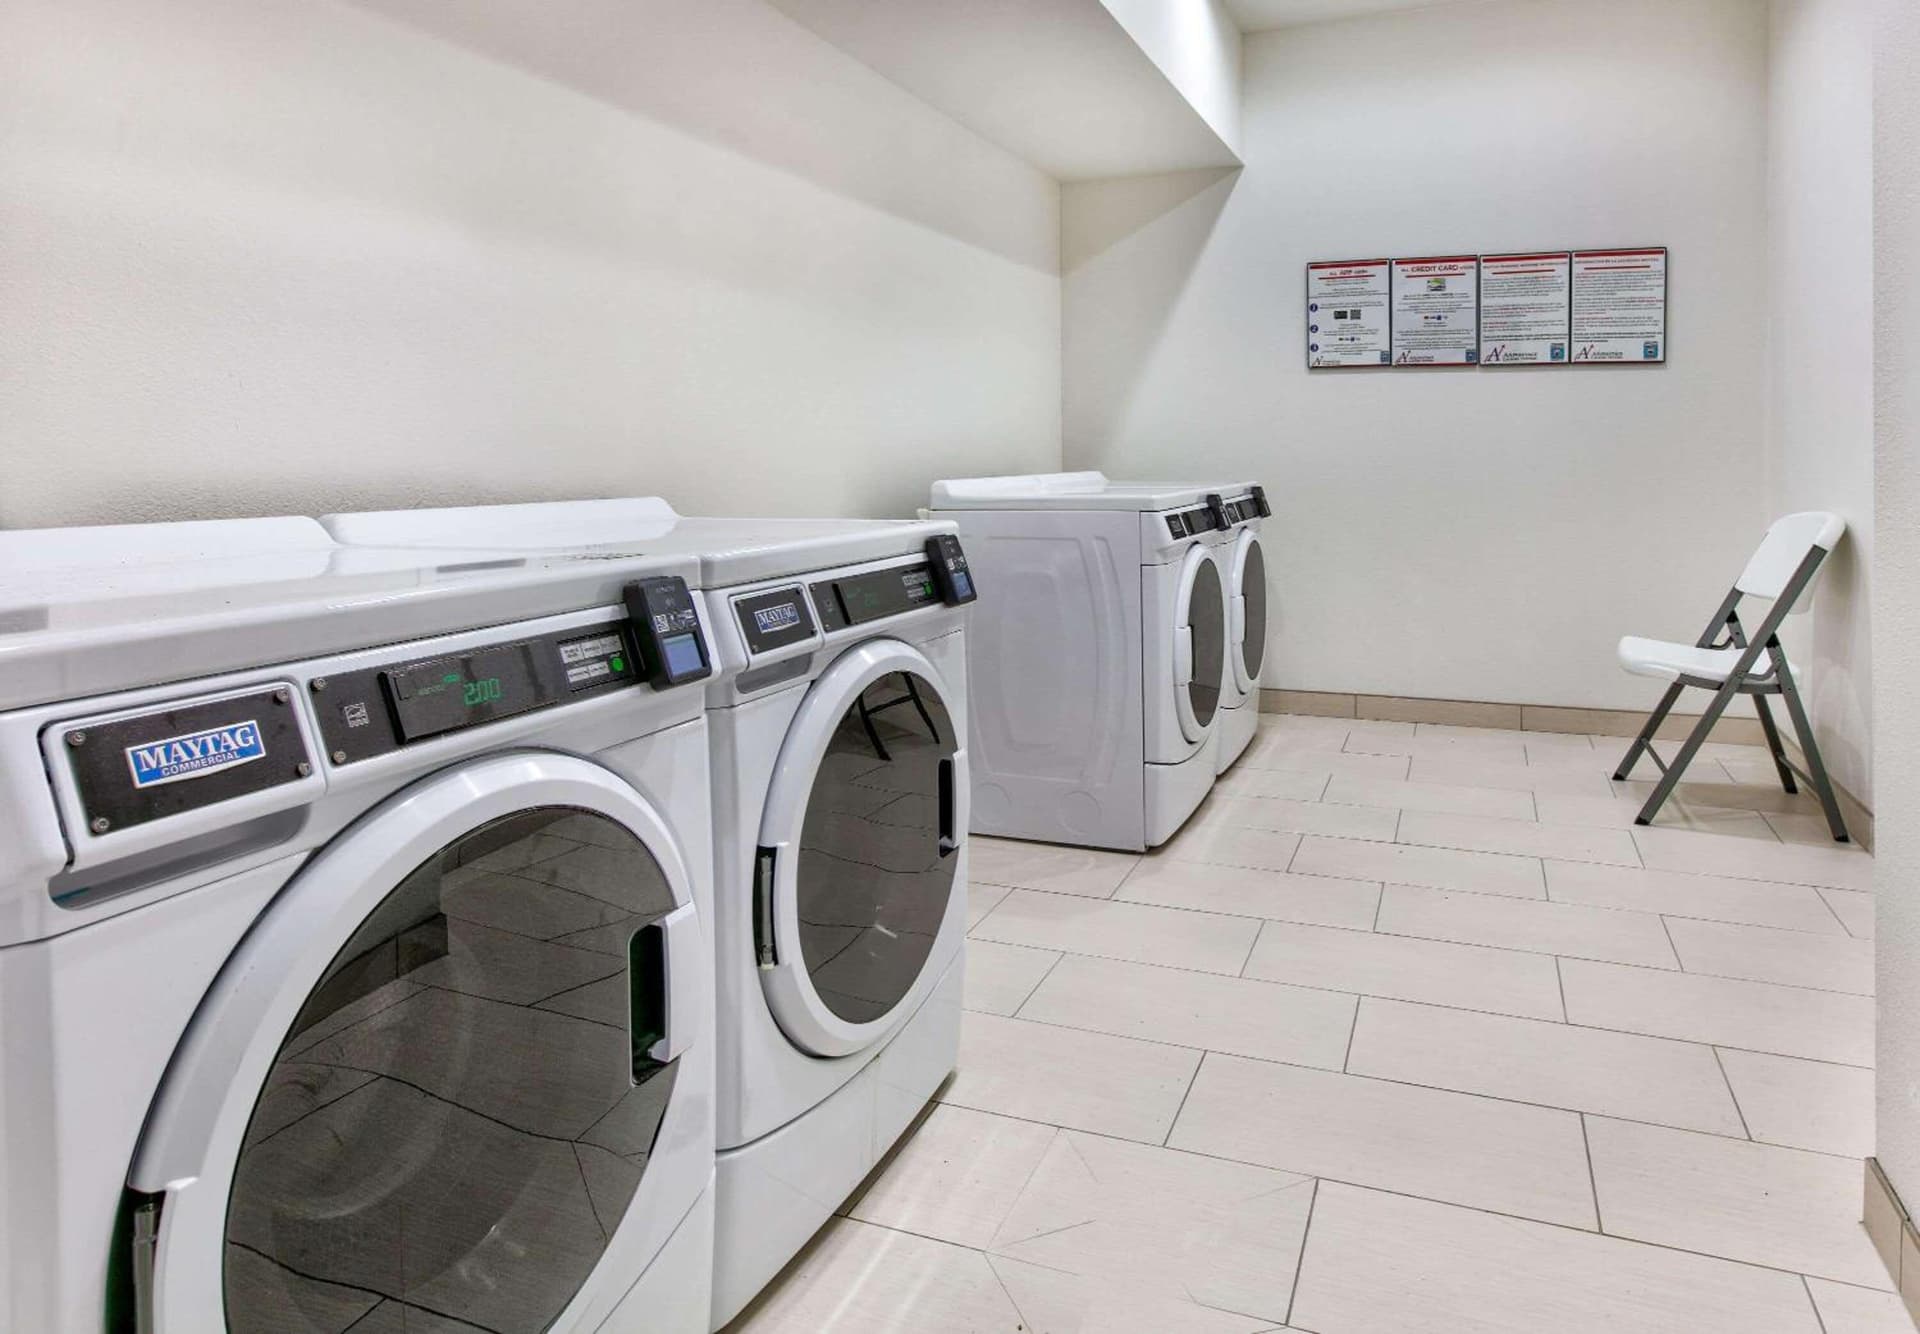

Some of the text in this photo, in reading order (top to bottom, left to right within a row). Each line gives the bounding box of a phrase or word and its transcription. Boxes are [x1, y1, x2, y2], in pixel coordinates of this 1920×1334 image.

[1411, 265, 1438, 273] CREDIT
[757, 606, 794, 624] MAYTAG
[136, 726, 256, 773] MAYTAG
[161, 751, 241, 776] COMMERCIAL
